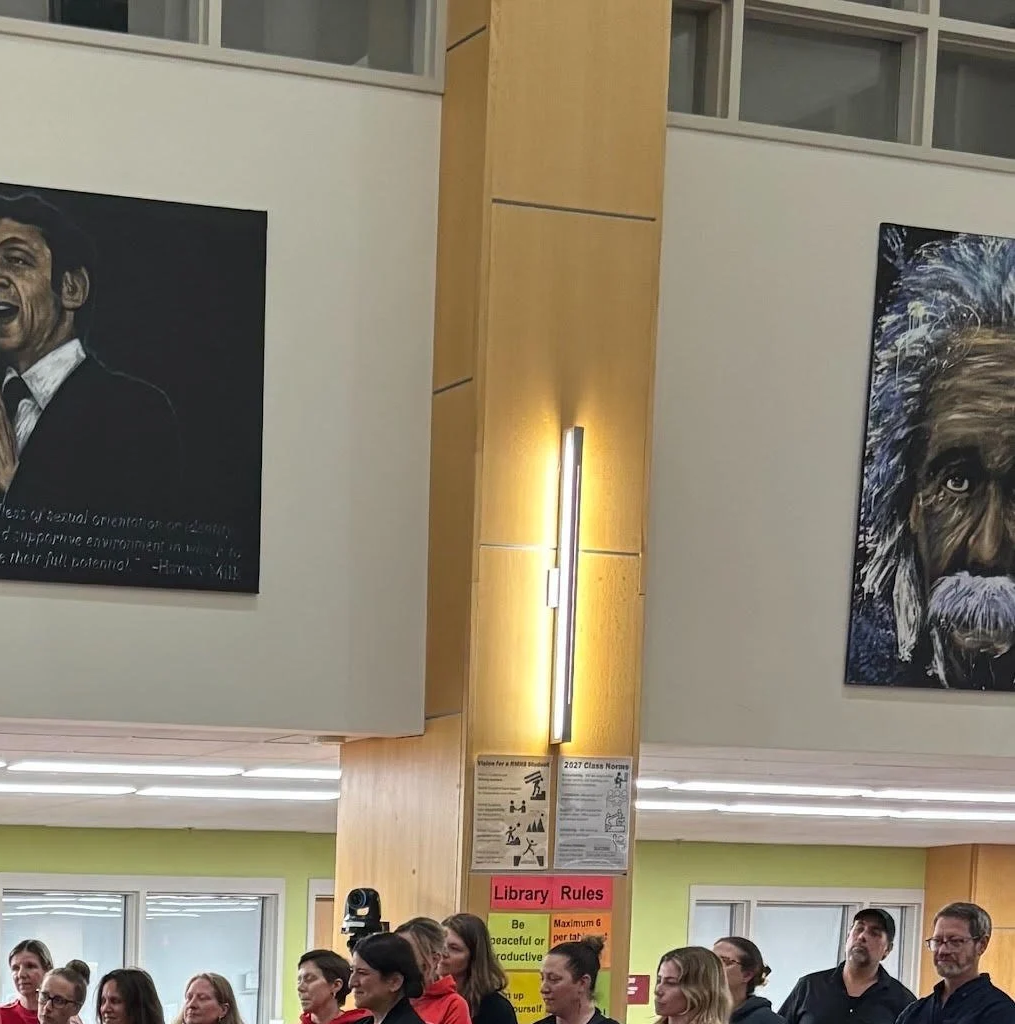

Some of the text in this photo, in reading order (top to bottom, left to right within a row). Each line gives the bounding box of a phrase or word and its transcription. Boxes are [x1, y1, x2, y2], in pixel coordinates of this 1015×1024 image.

[29, 510, 44, 524] of
[46, 508, 89, 525] sexual
[15, 530, 82, 548] supportive
[86, 536, 165, 553] environment
[9, 550, 42, 566] their
[43, 550, 68, 569] full
[564, 761, 630, 770] 2027 Class Norms
[494, 885, 605, 905] Library Rules
[511, 919, 525, 930] Be
[553, 918, 602, 928] Maximum 6
[534, 938, 546, 946] or
[553, 934, 568, 943] per
[494, 951, 543, 962] roductive
[513, 992, 524, 1002] up
[512, 1003, 543, 1013] ourself
